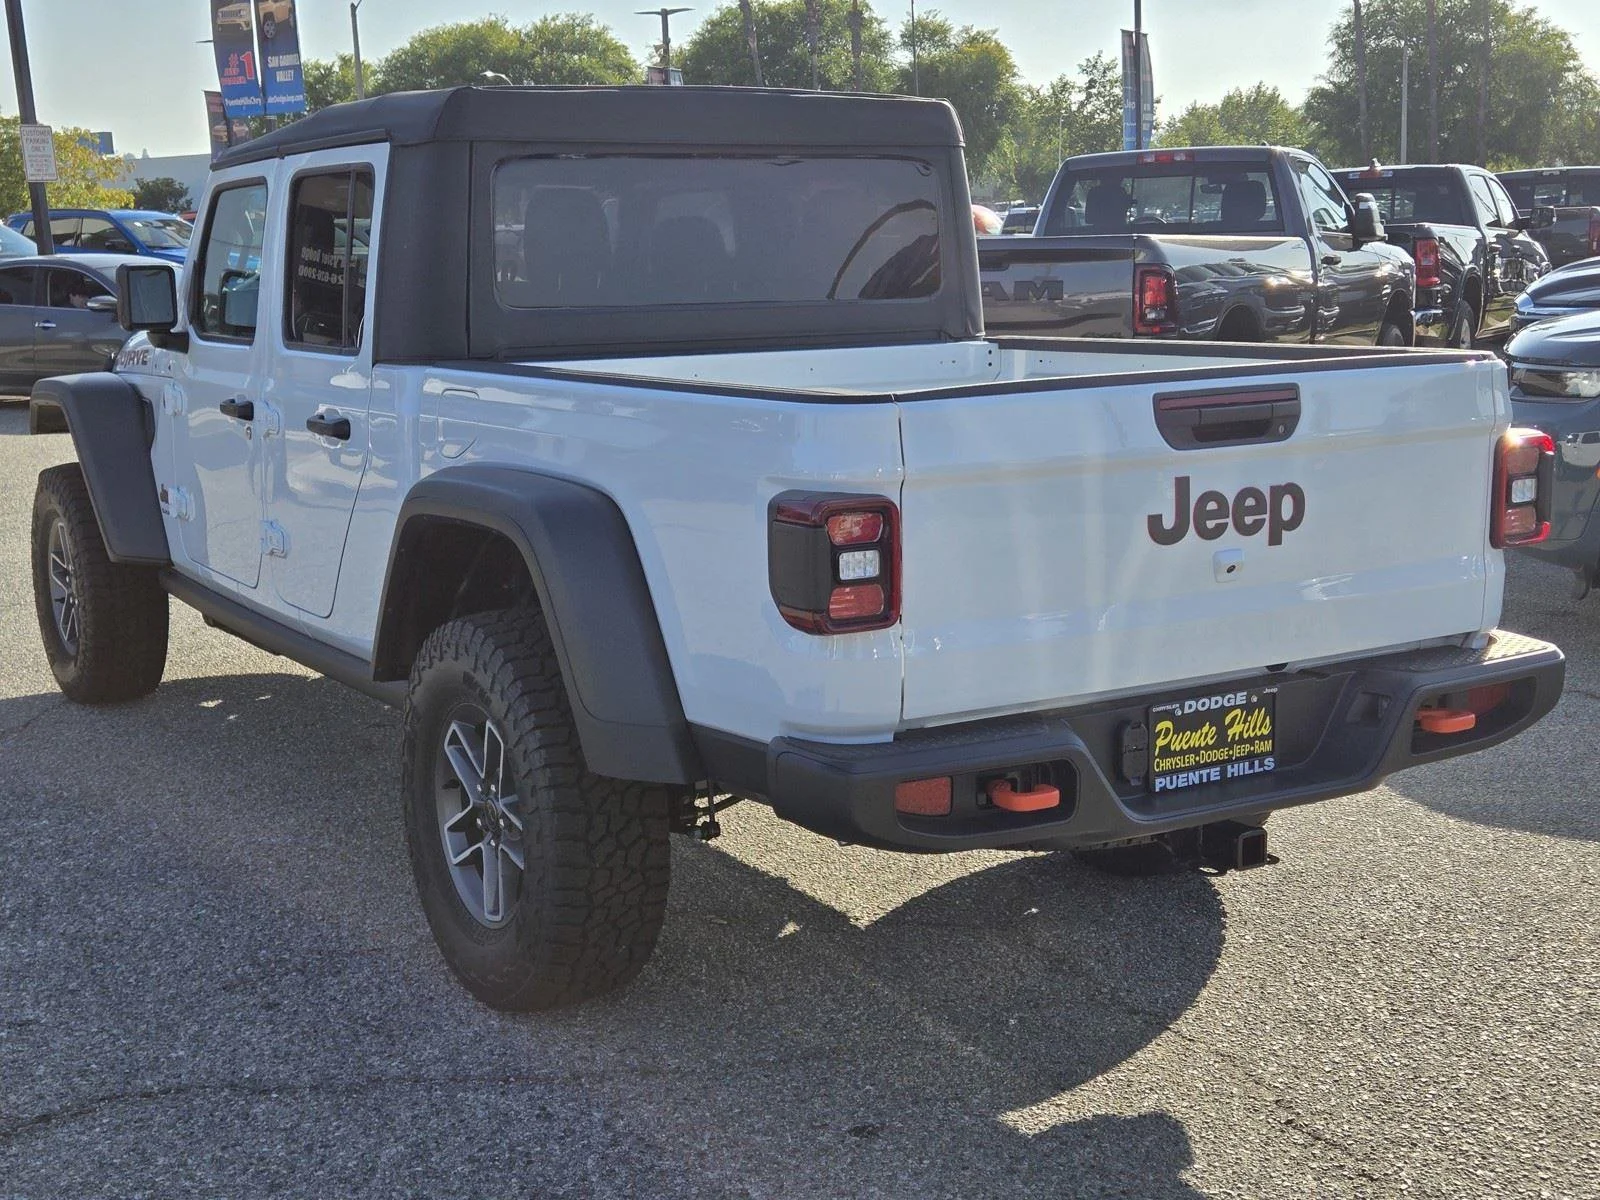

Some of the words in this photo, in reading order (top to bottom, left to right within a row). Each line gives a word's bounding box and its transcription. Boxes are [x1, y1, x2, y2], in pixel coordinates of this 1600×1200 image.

[229, 51, 254, 80] #1
[23, 129, 51, 137] CUSTOMER
[980, 280, 1064, 300] AM
[1148, 476, 1305, 546] Jeep
[1152, 703, 1180, 713] CHRYSLER
[1184, 692, 1247, 713] DODGE
[1154, 720, 1217, 756] Puente
[1224, 707, 1272, 742] Hills
[1154, 767, 1221, 792] PUENTE
[1226, 757, 1275, 778] HILLS
